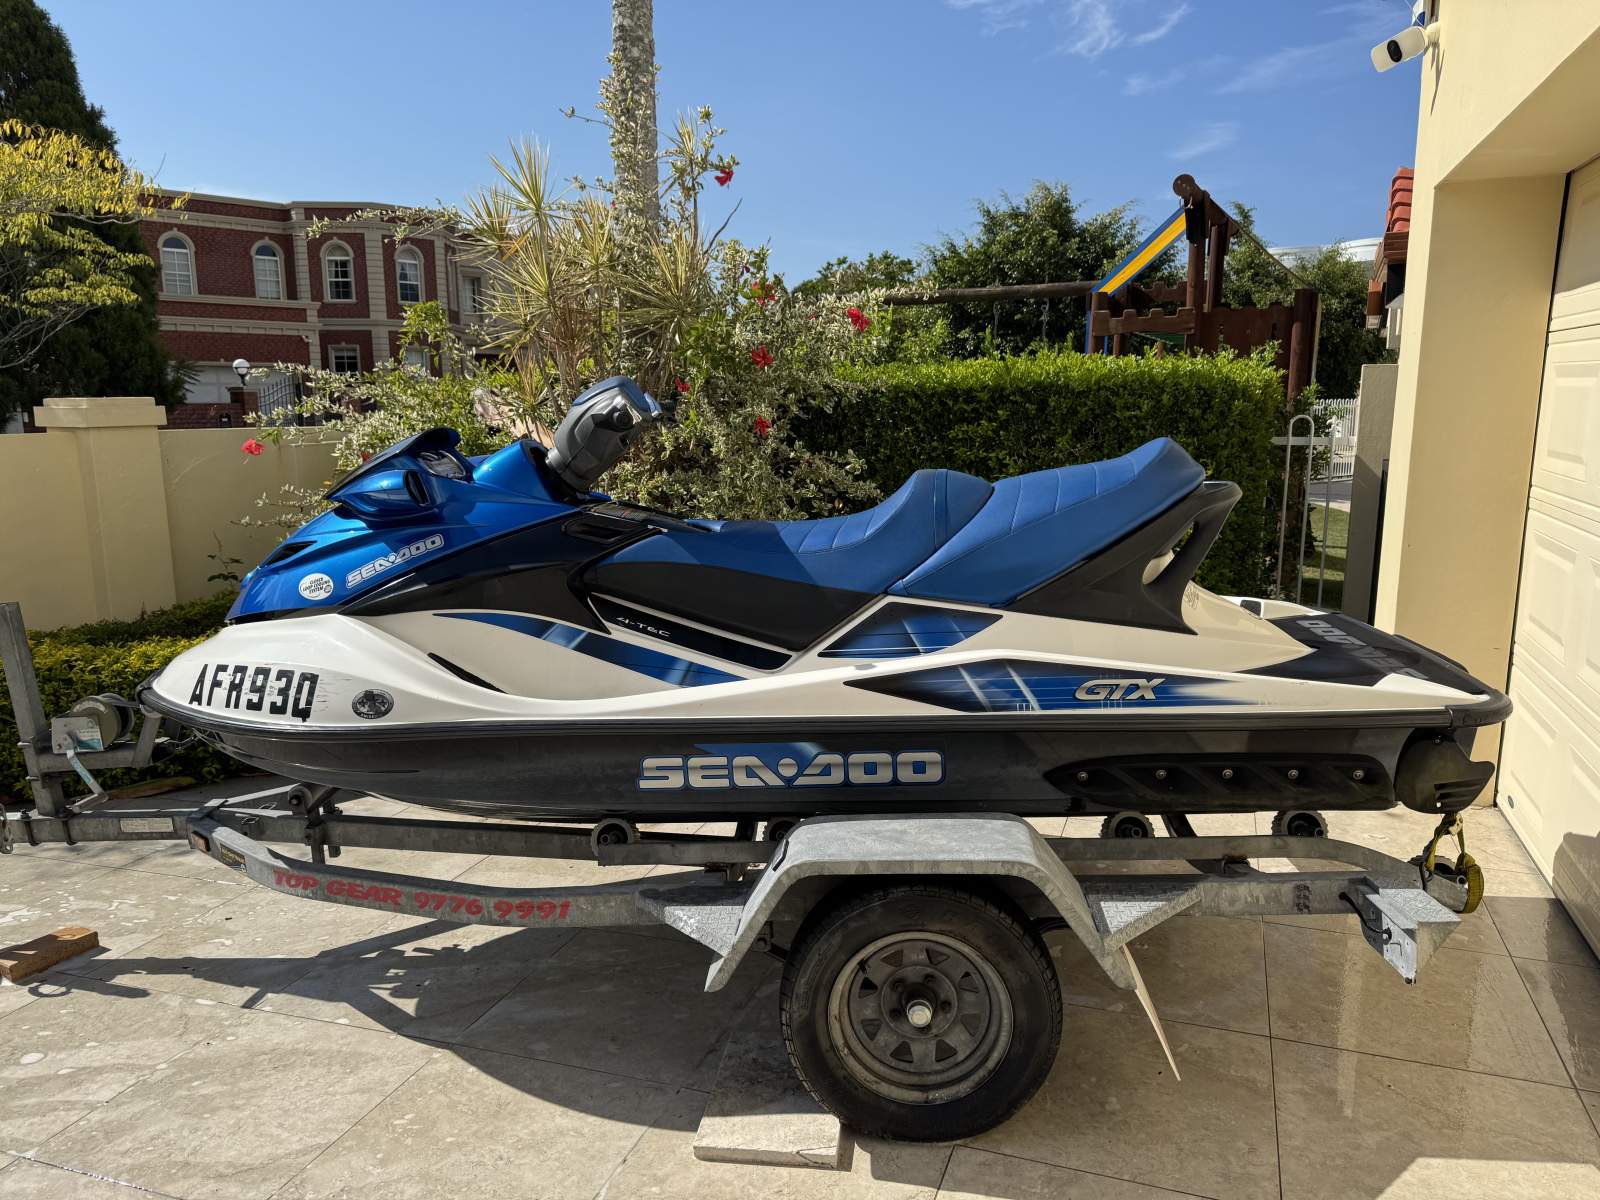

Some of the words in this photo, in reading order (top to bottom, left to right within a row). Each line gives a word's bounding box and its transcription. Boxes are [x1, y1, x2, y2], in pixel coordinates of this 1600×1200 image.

[1074, 678, 1166, 701] GTX
[272, 868, 320, 890] TOP
[326, 879, 403, 906] GEAR
[415, 891, 483, 916] 9776
[494, 899, 571, 920] 9991
